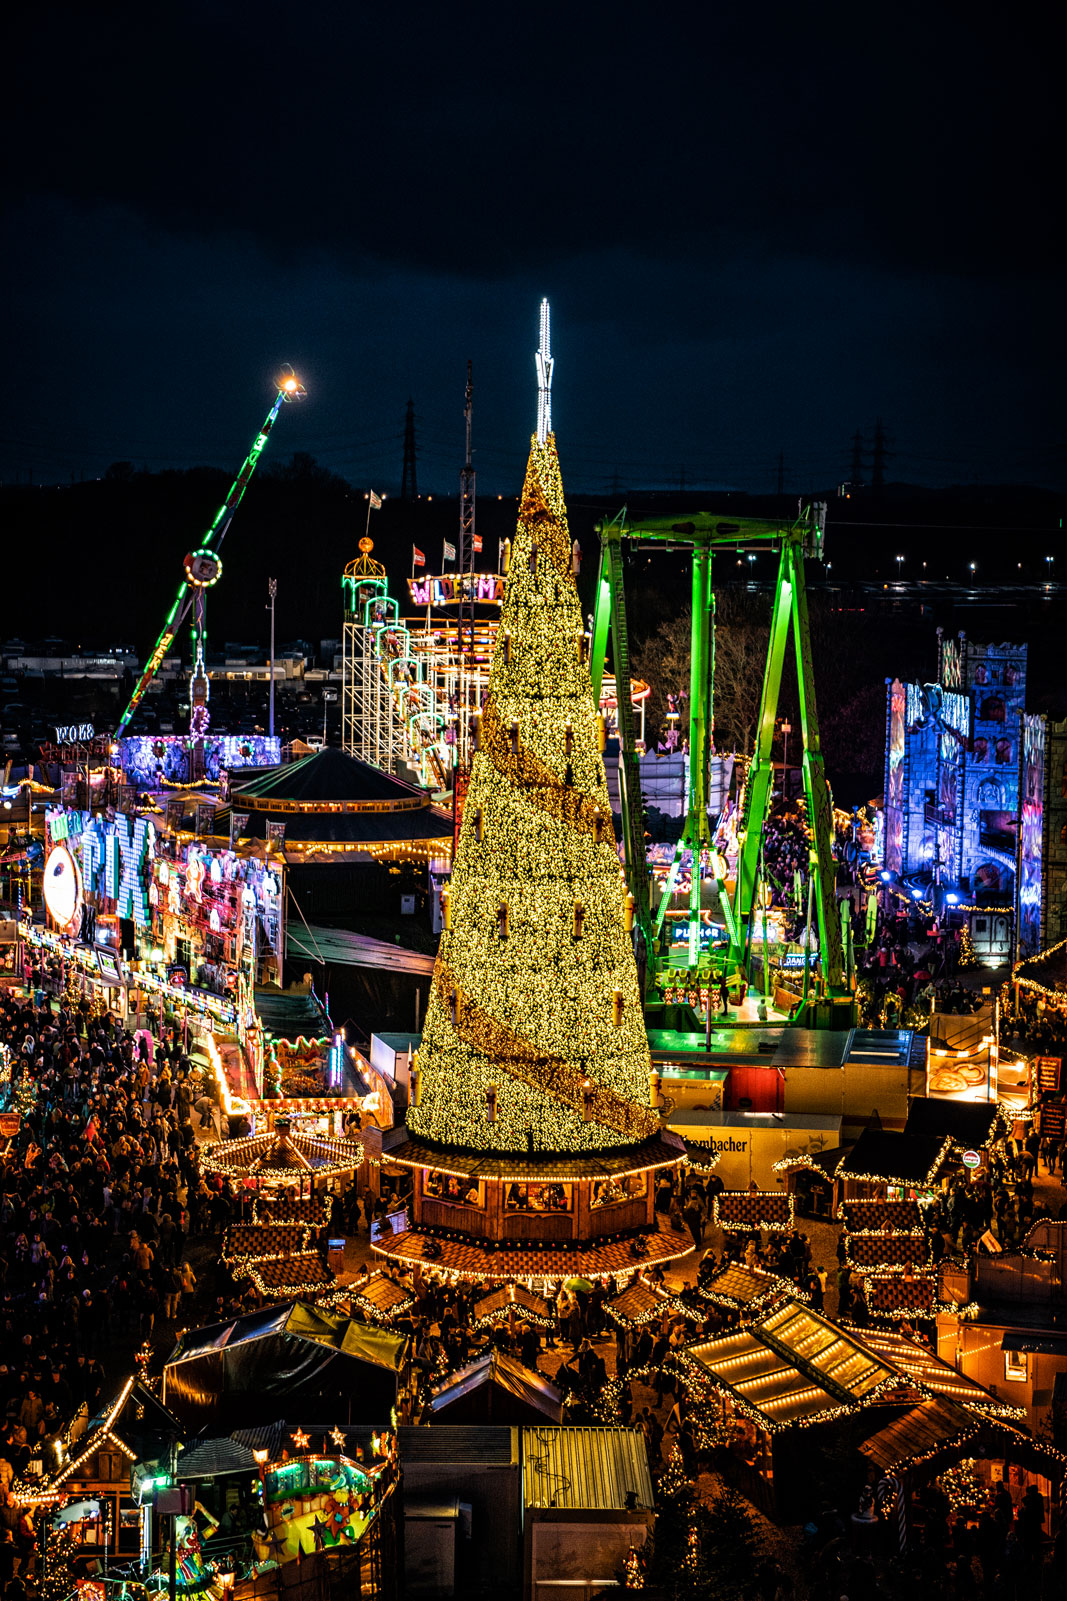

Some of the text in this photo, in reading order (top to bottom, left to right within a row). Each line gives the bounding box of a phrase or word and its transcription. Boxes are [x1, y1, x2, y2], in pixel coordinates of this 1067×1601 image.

[412, 578, 504, 603] WILDE MA
[675, 928, 719, 938] PUHER
[685, 1136, 747, 1152] ombacher
